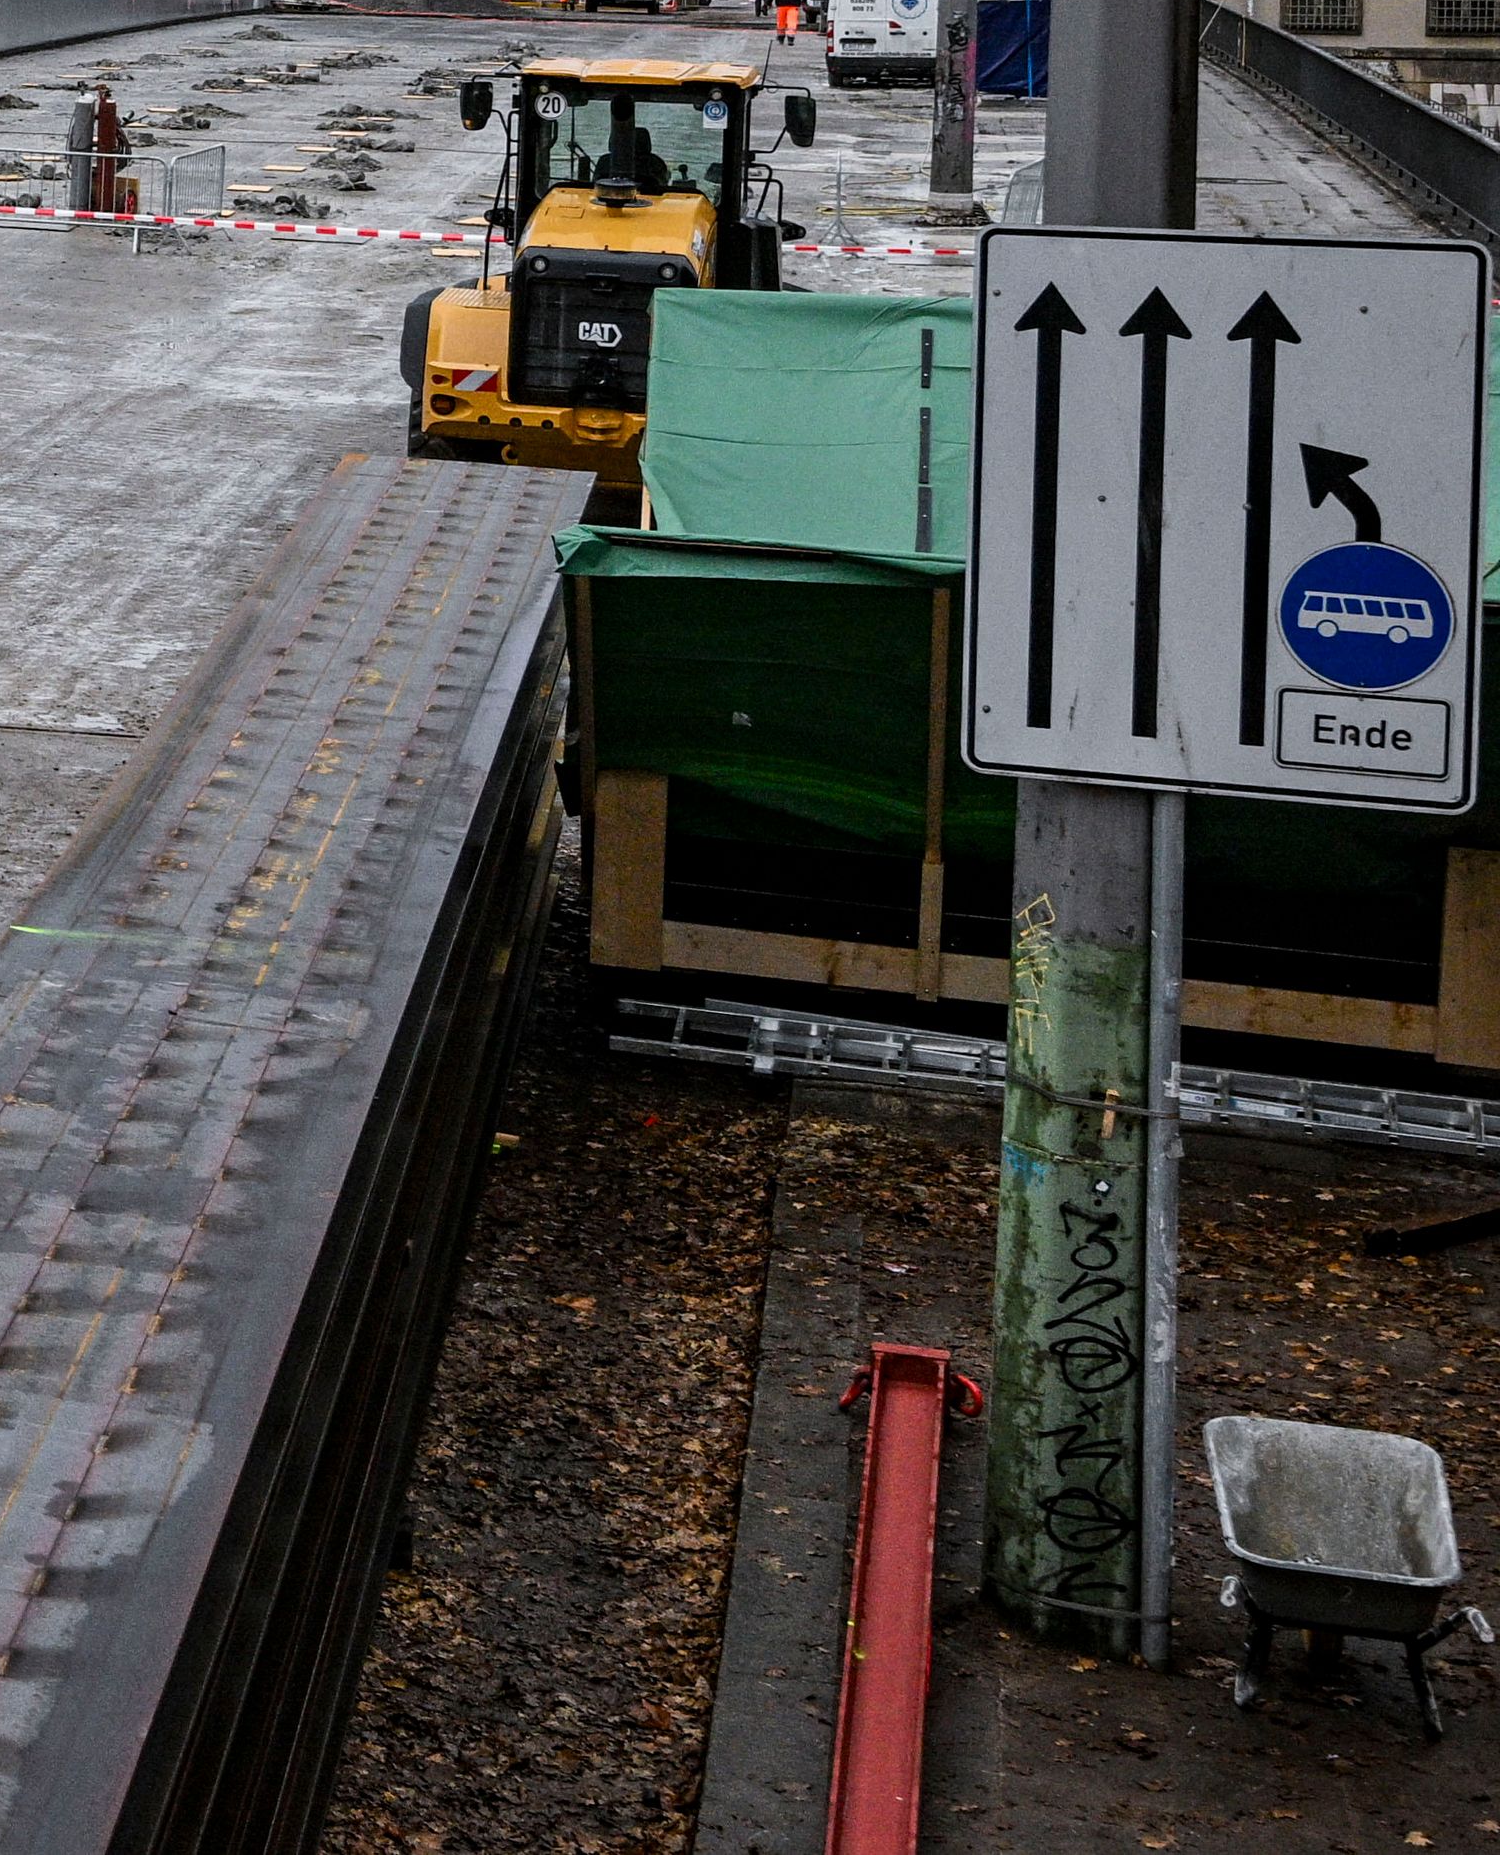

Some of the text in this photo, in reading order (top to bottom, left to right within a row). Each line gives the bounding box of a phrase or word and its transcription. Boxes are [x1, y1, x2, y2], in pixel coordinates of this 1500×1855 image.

[542, 97, 560, 114] 20
[579, 321, 610, 342] CAT
[1314, 714, 1413, 752] Ende
